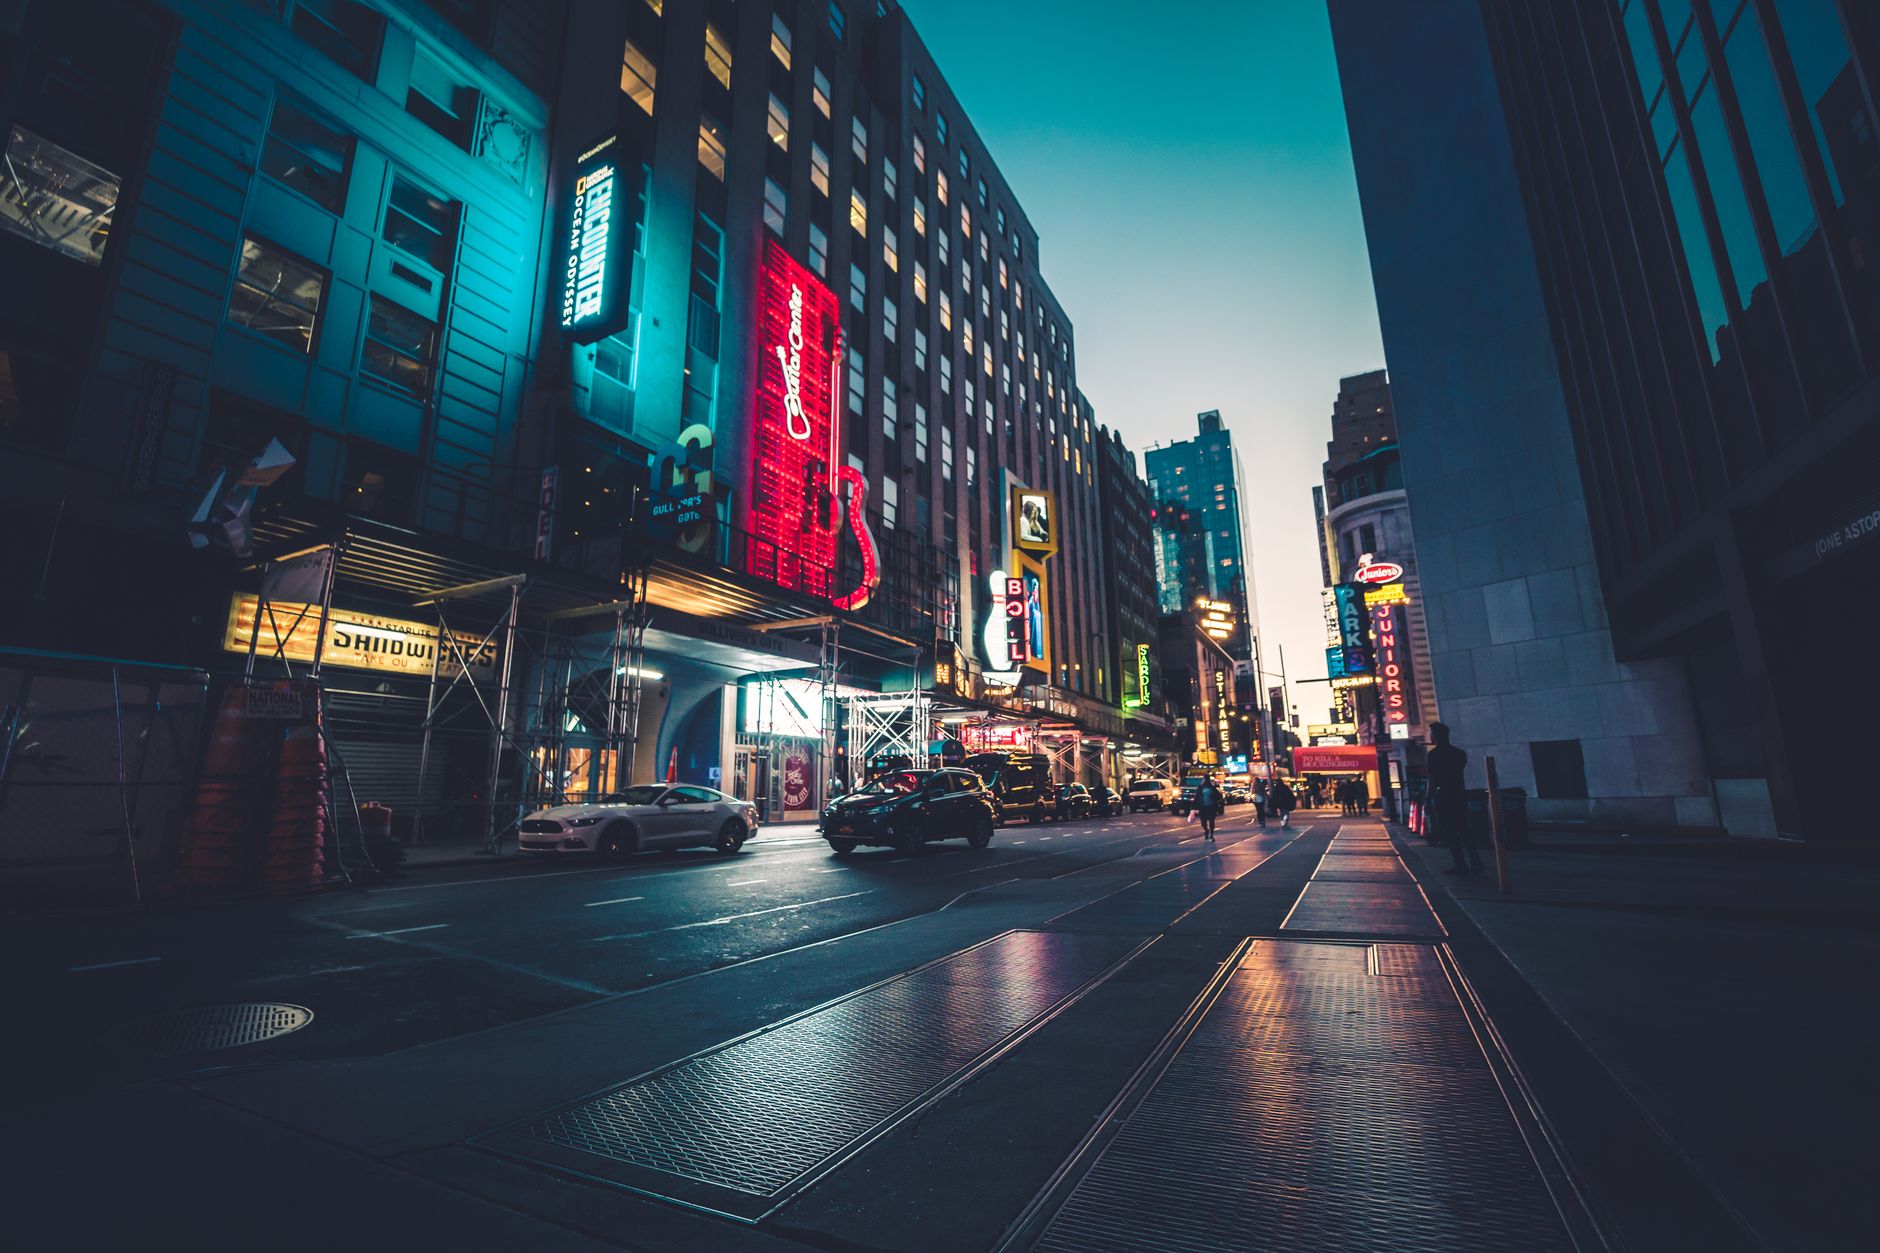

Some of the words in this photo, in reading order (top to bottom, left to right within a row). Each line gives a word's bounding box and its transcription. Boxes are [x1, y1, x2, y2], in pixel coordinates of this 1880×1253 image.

[570, 195, 584, 251] OCEAN
[574, 177, 613, 323] ENCOUNTER
[562, 254, 578, 326] ODYSSEY
[788, 283, 804, 351] Center
[775, 346, 811, 440] Guitar
[1360, 567, 1398, 581] Junior's
[1815, 531, 1842, 559] (ONE
[1006, 579, 1024, 660] BOL
[1343, 587, 1361, 647] PARK
[354, 652, 385, 667] TAKE
[392, 658, 409, 668] OU
[1139, 646, 1150, 706] SARDI'S
[1378, 604, 1404, 708] JUNIORS
[249, 691, 301, 705] NATIONAL
